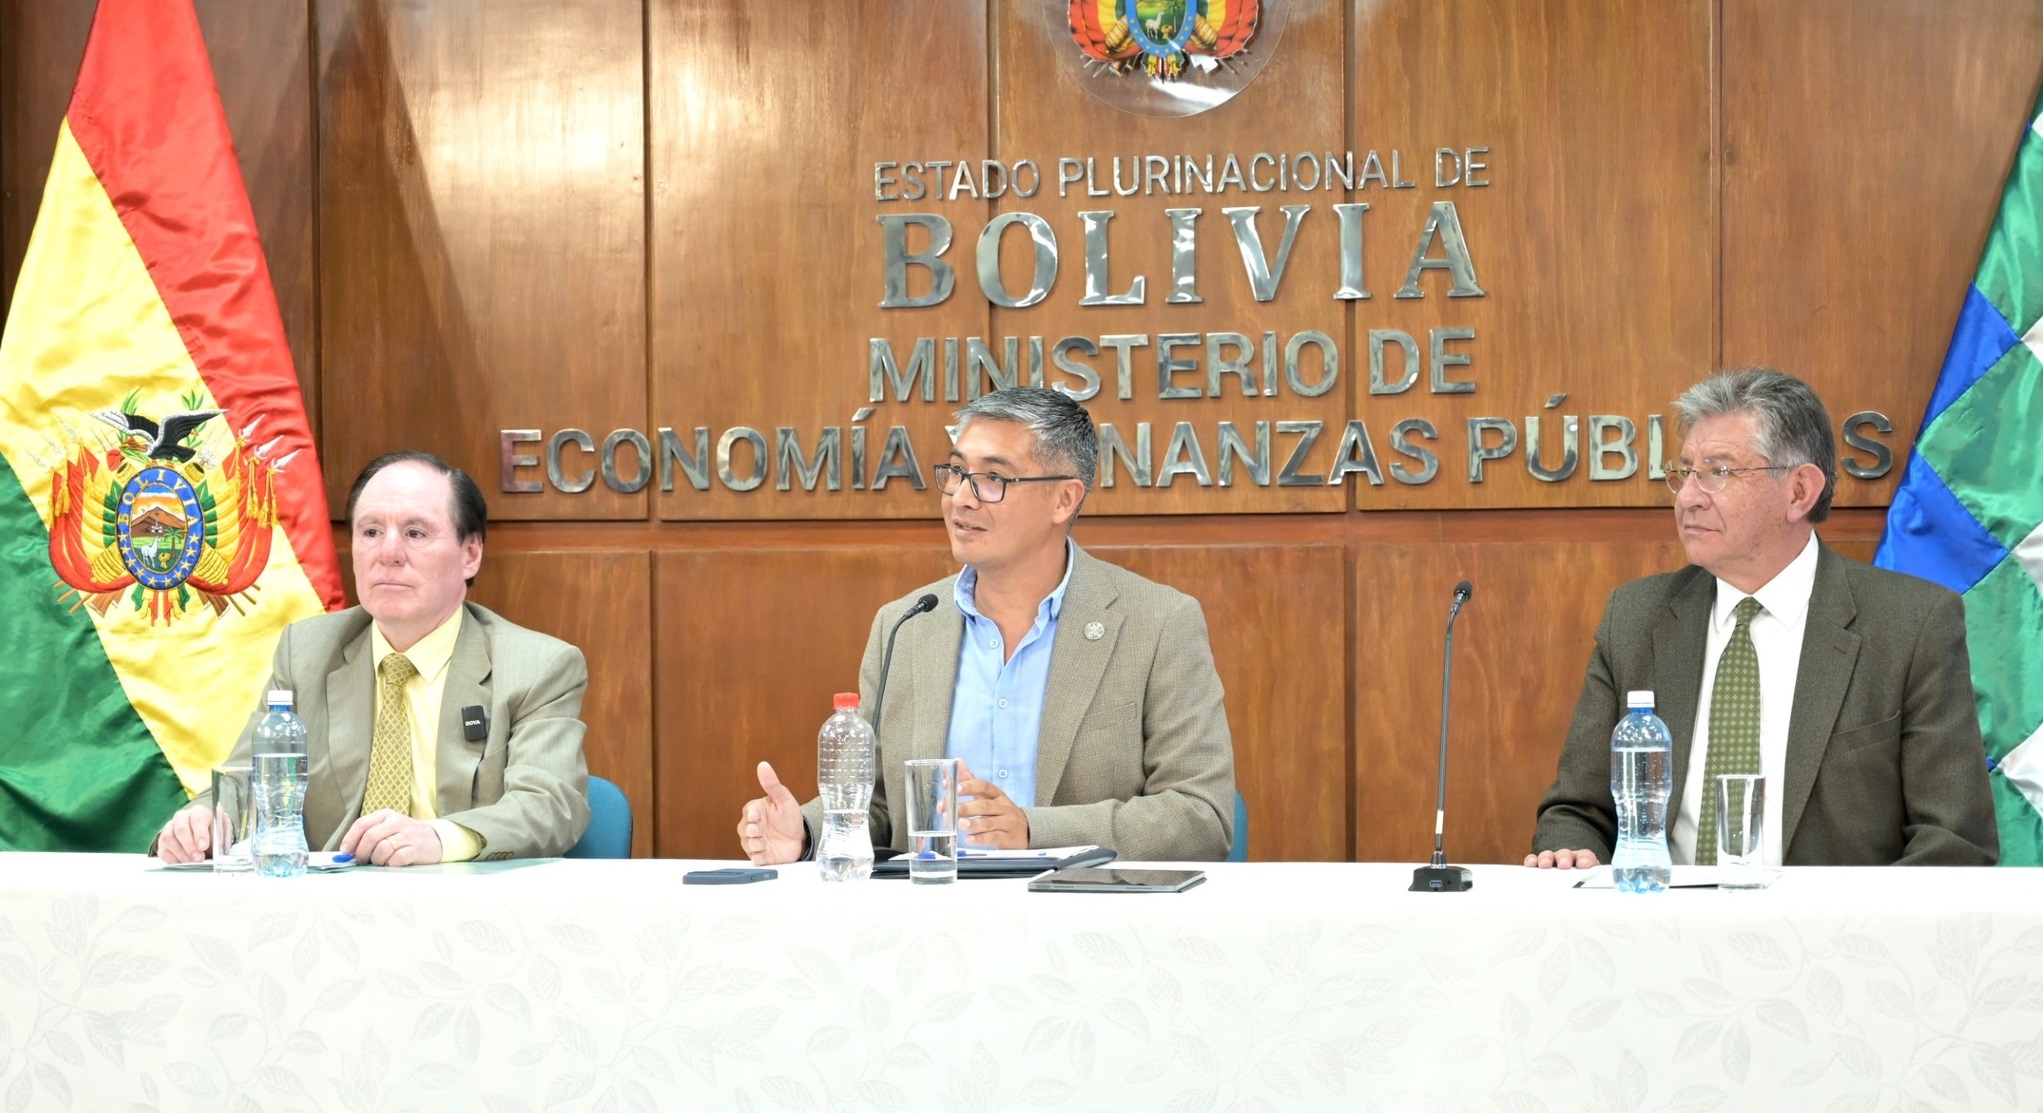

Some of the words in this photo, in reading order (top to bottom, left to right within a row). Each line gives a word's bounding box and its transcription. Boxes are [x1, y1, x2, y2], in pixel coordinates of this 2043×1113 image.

[874, 158, 1040, 202] ESTADO
[1059, 149, 1416, 197] PLURINACIONAL
[1434, 146, 1490, 188] DE
[876, 201, 1487, 309] BOLIVIA
[869, 330, 1339, 402] MINISTERIO
[1368, 327, 1477, 396] DE
[499, 407, 927, 494] ECONOMÍA
[1099, 419, 1438, 487] NANZAS
[1467, 393, 1894, 484] PÚBLS
[117, 468, 200, 528] BOLIVIA
